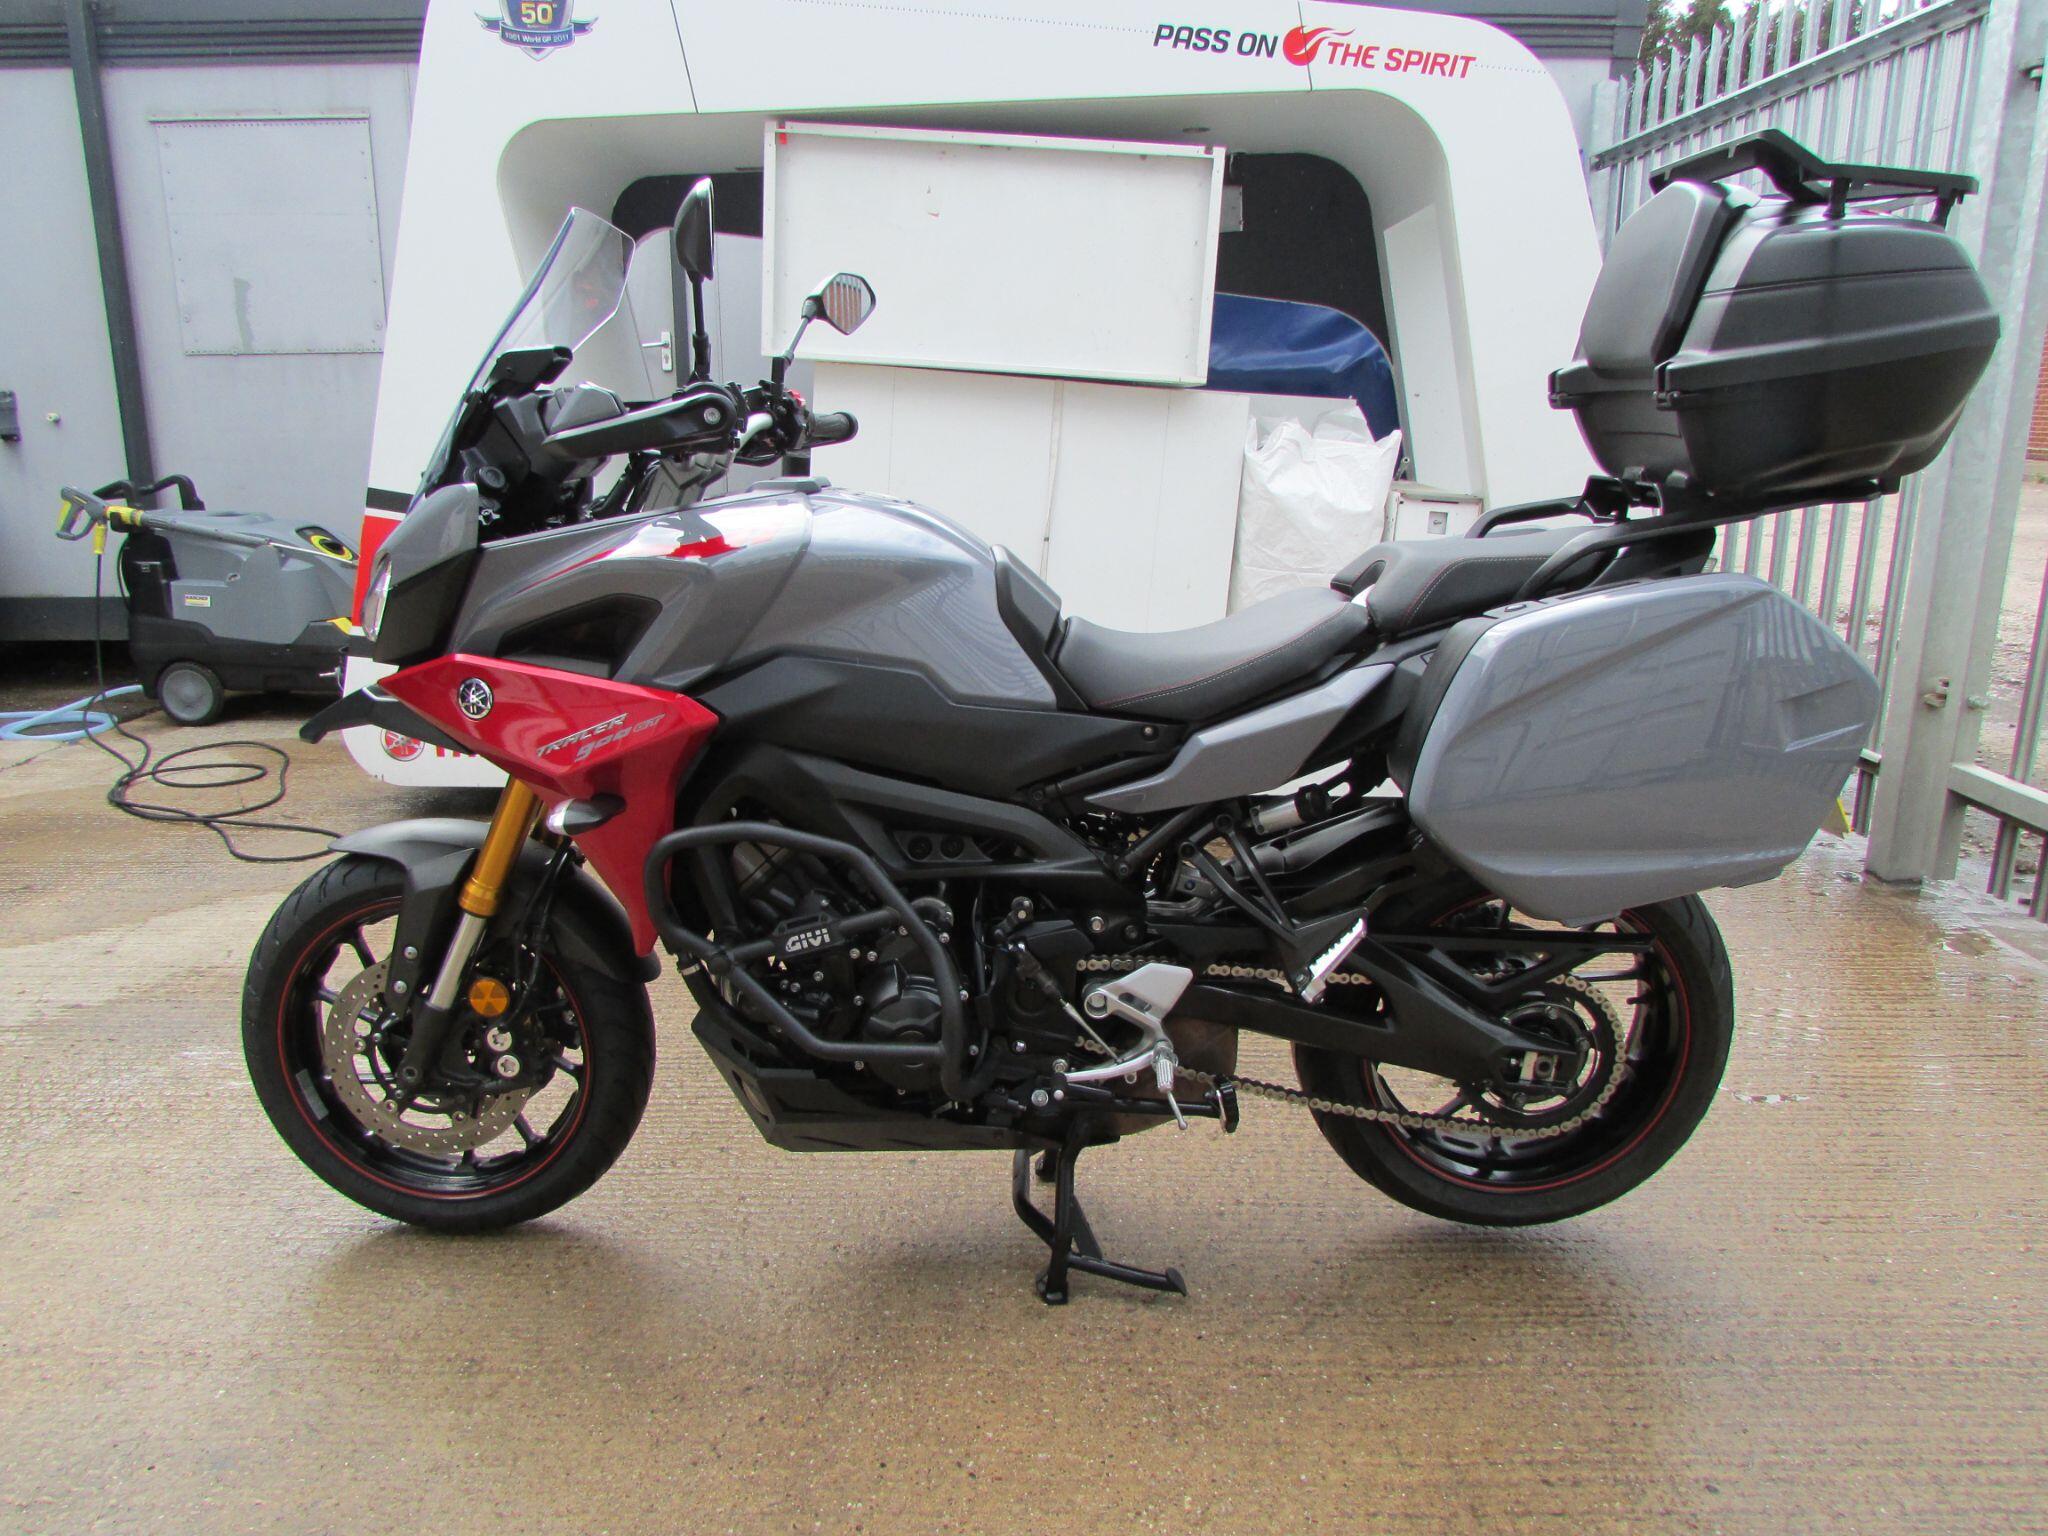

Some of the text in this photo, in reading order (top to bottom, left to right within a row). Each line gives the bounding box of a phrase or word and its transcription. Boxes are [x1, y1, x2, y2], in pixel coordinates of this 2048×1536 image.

[1153, 24, 1476, 78] PASS ON THE SPIRIT
[785, 928, 831, 953] GIVI
